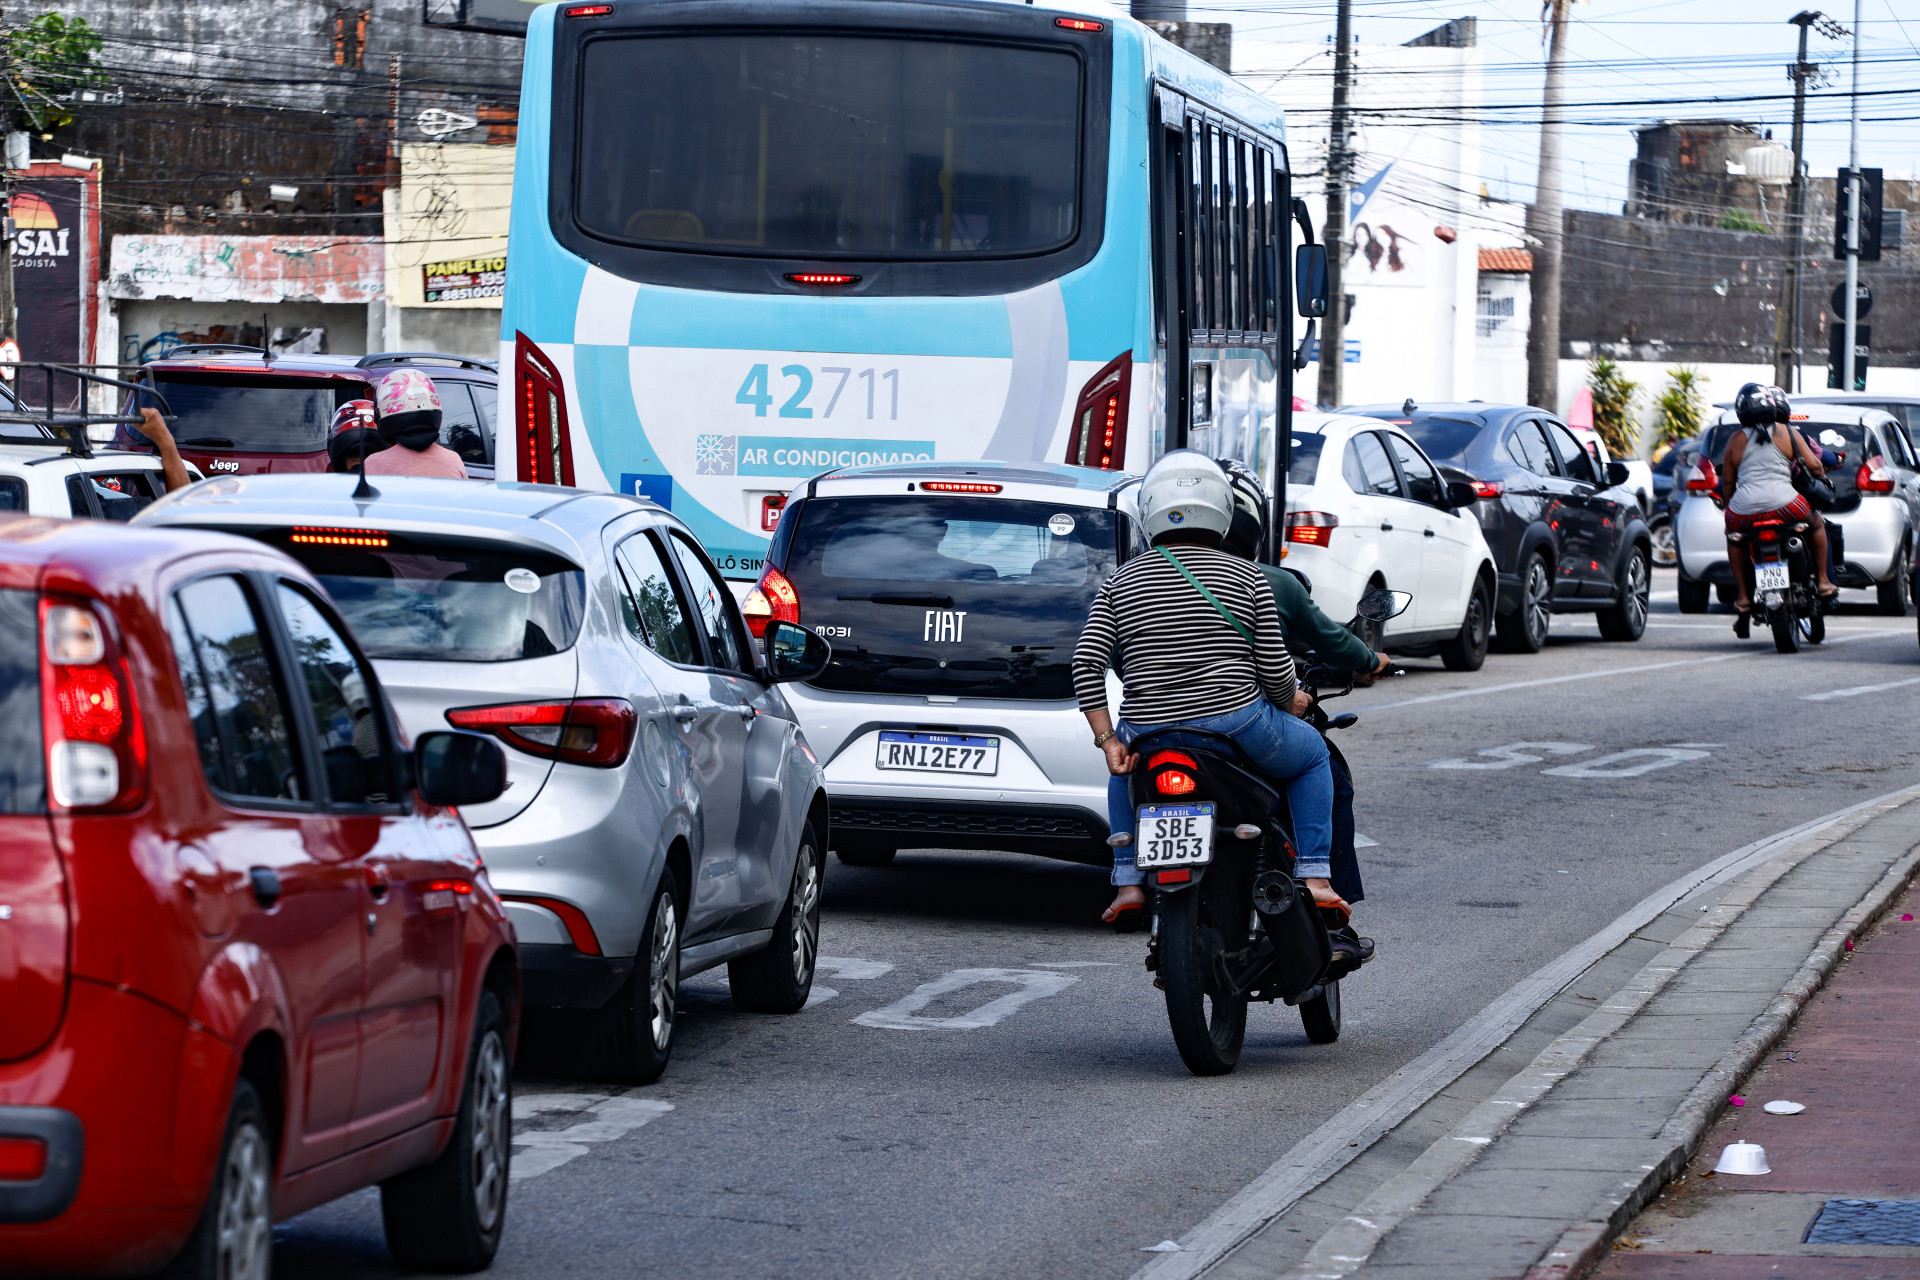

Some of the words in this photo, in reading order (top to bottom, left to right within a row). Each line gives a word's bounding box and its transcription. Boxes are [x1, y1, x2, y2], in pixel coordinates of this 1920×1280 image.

[426, 258, 505, 276] PANFLETO
[736, 364, 898, 420] 42711
[210, 459, 239, 472] Jeep
[742, 448, 768, 465] AR
[773, 449, 930, 467] CONDICIONADO
[816, 626, 851, 637] MOBI
[924, 611, 967, 642] FIAT
[888, 744, 986, 769] RNI2E77
[1155, 817, 1197, 839] SBE
[1147, 838, 1203, 861] 3D53
[1138, 857, 1146, 865] BR
